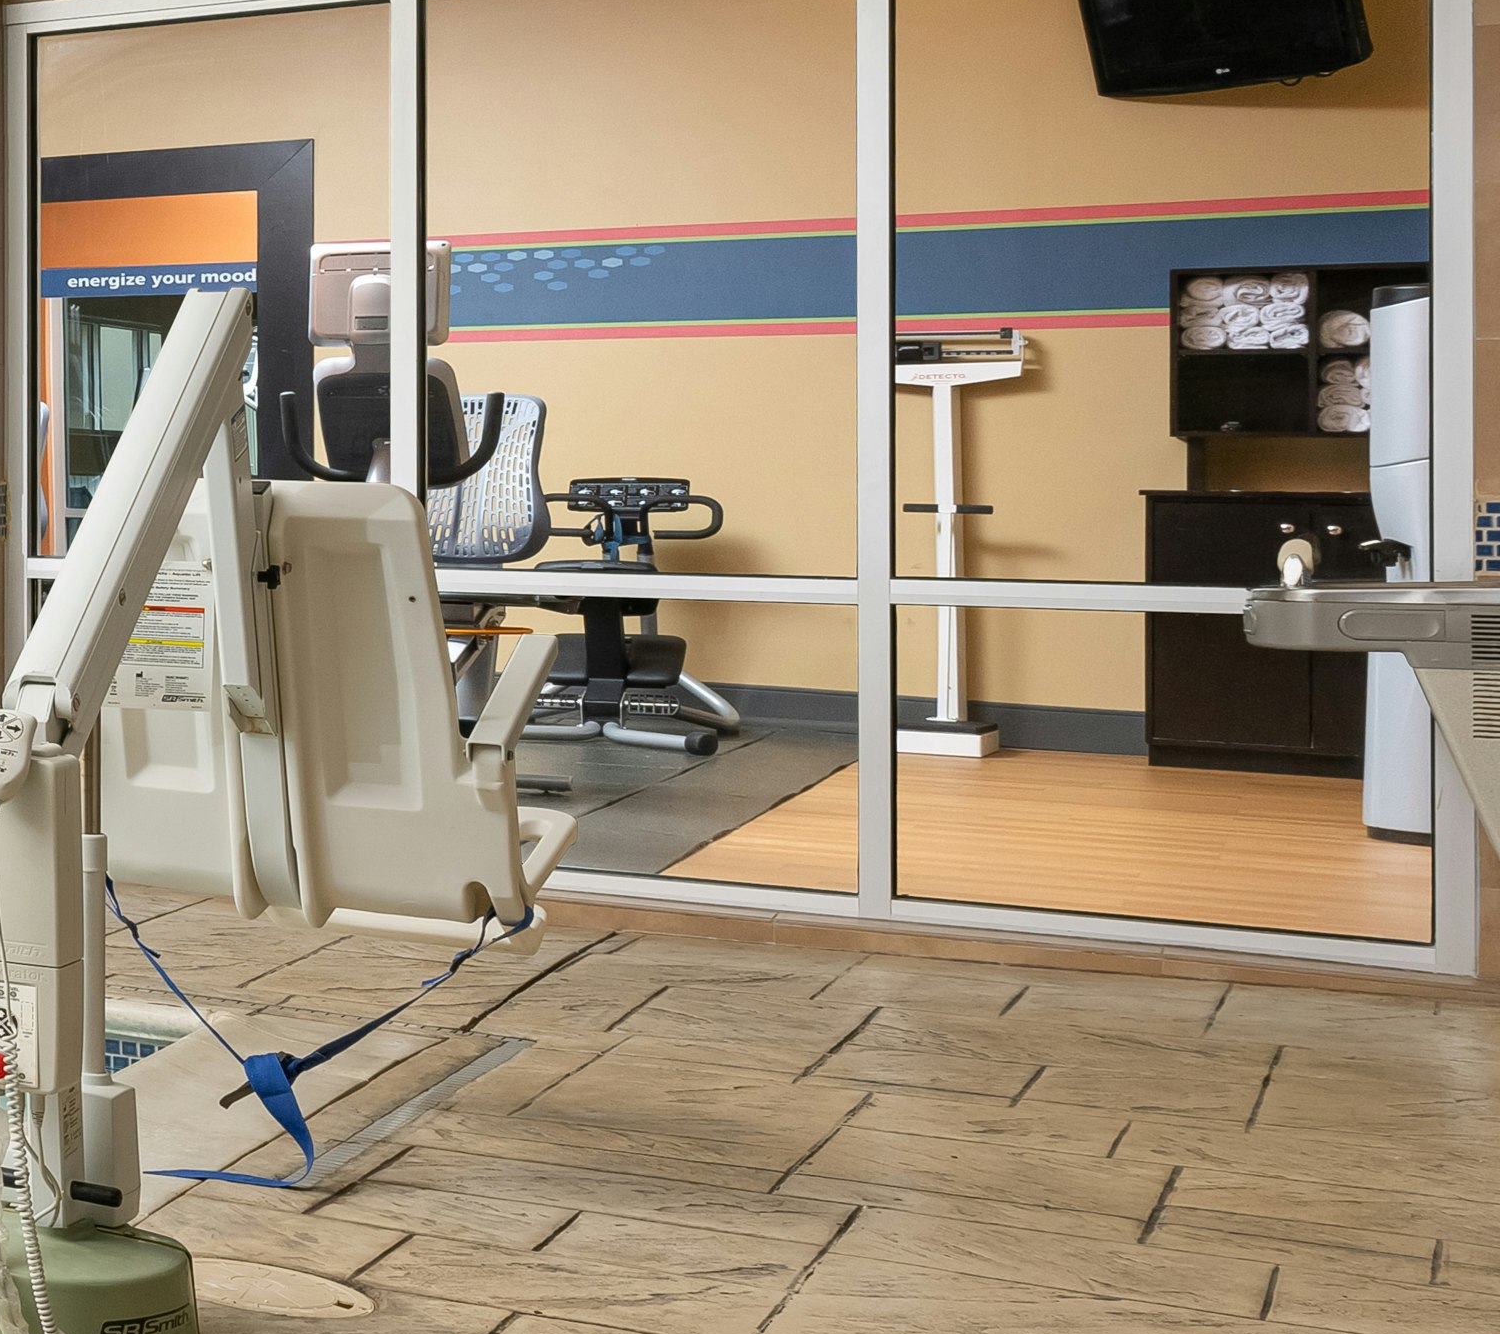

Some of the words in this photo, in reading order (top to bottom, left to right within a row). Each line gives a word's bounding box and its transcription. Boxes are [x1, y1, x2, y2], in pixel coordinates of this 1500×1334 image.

[67, 272, 146, 290] energize
[151, 272, 195, 288] your
[200, 268, 257, 283] mood
[144, 1309, 189, 1334] Smith
